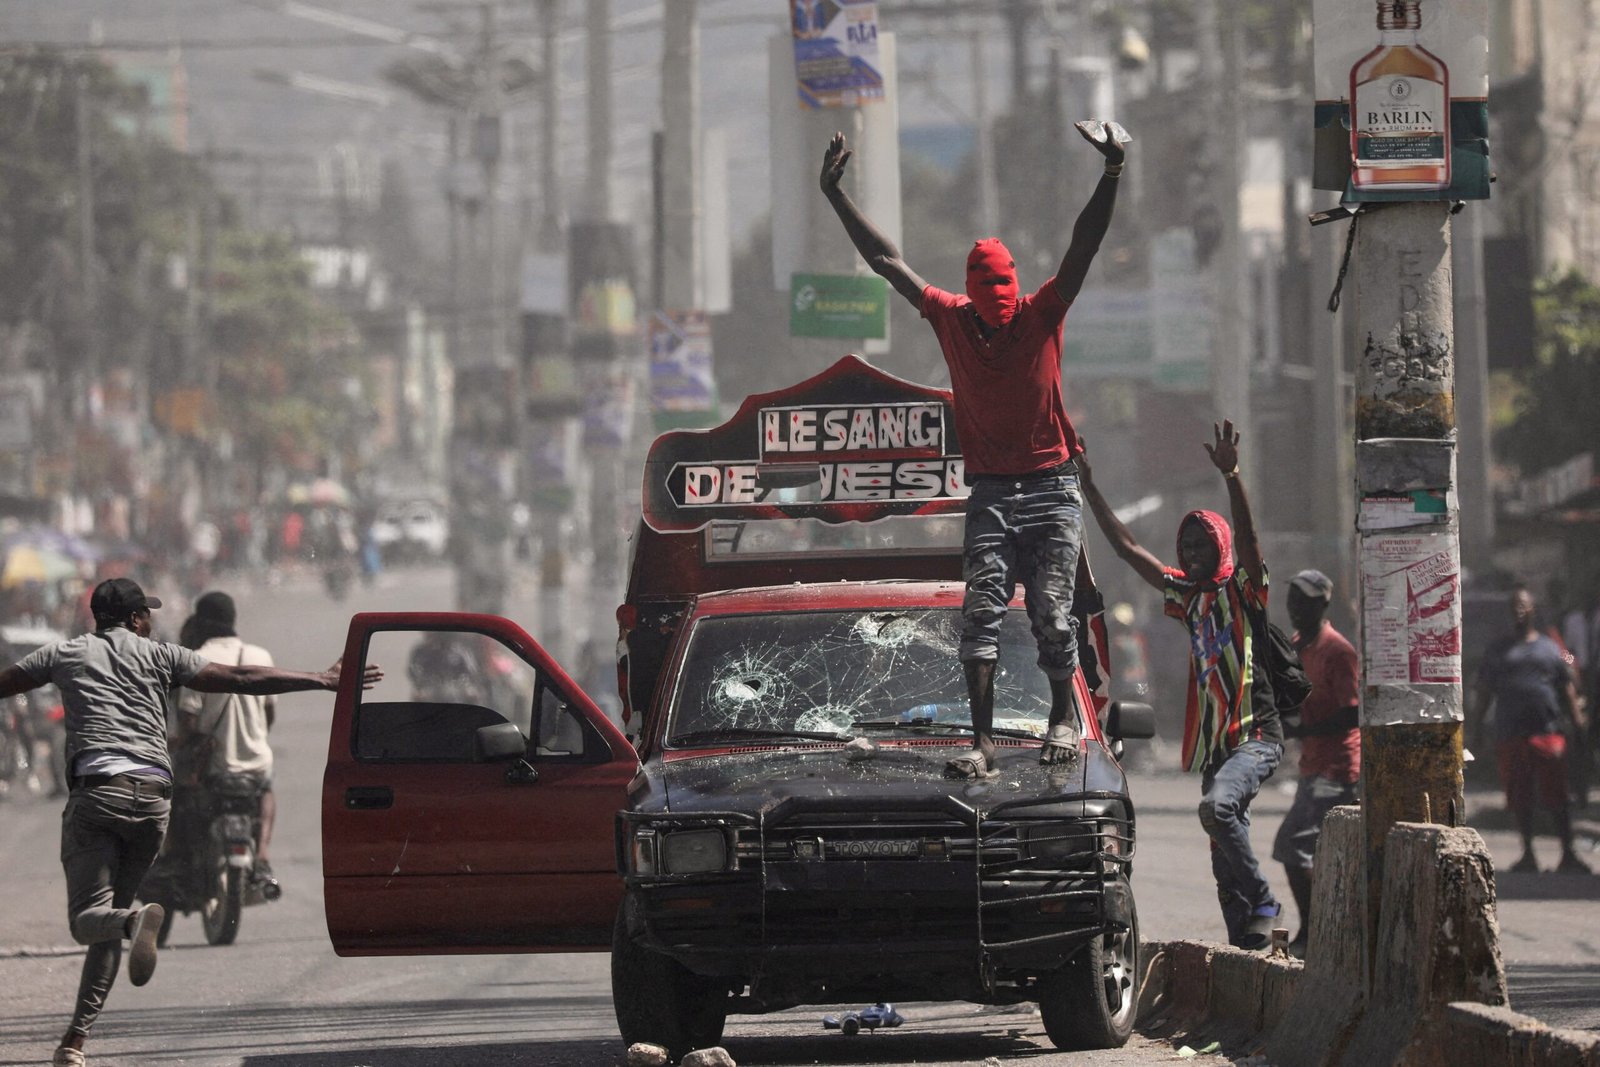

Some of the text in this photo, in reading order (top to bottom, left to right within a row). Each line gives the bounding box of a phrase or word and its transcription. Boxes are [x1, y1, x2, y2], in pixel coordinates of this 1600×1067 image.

[1368, 111, 1432, 124] BARLIN
[685, 465, 757, 504] DE
[836, 841, 919, 855] TOYOTA
